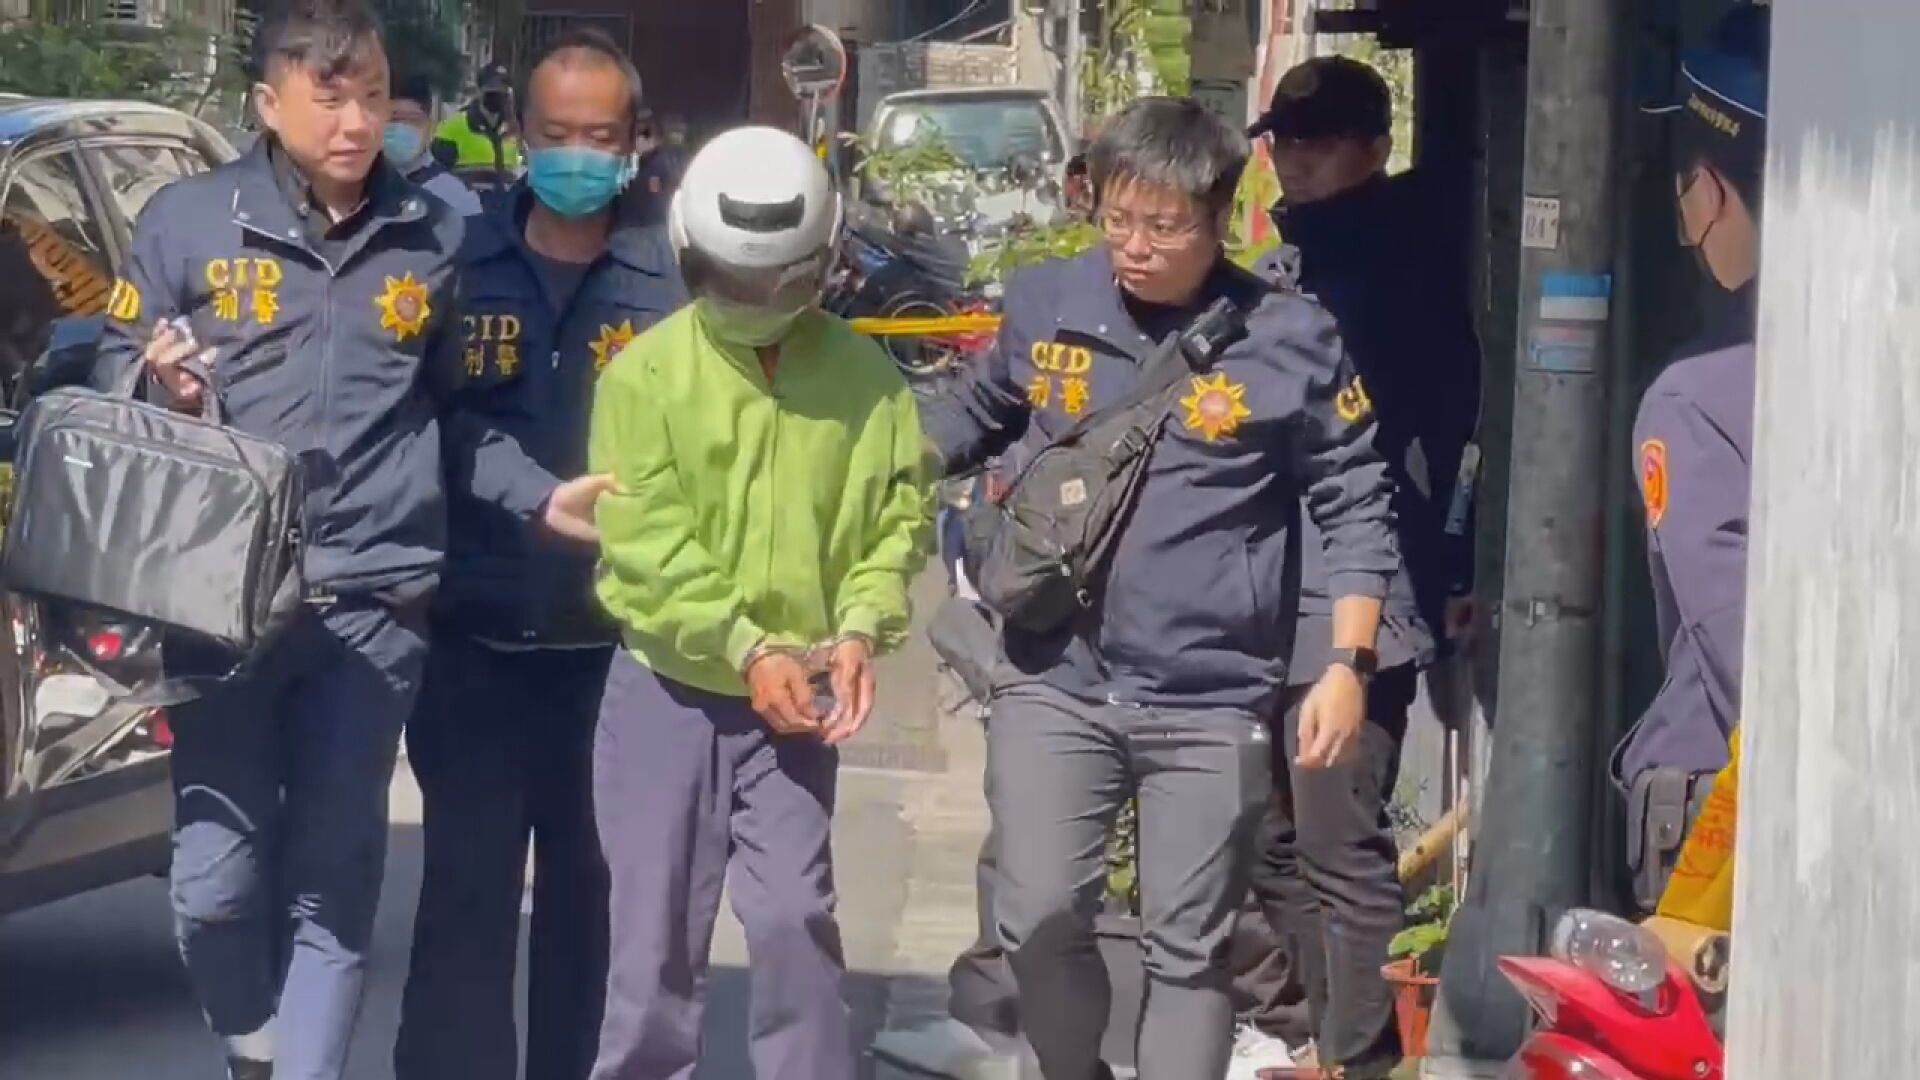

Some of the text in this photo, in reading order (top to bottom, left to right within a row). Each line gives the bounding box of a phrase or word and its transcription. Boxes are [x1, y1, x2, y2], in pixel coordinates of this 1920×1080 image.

[205, 257, 282, 289] CID
[462, 314, 521, 341] CID
[1031, 341, 1092, 373] CID
